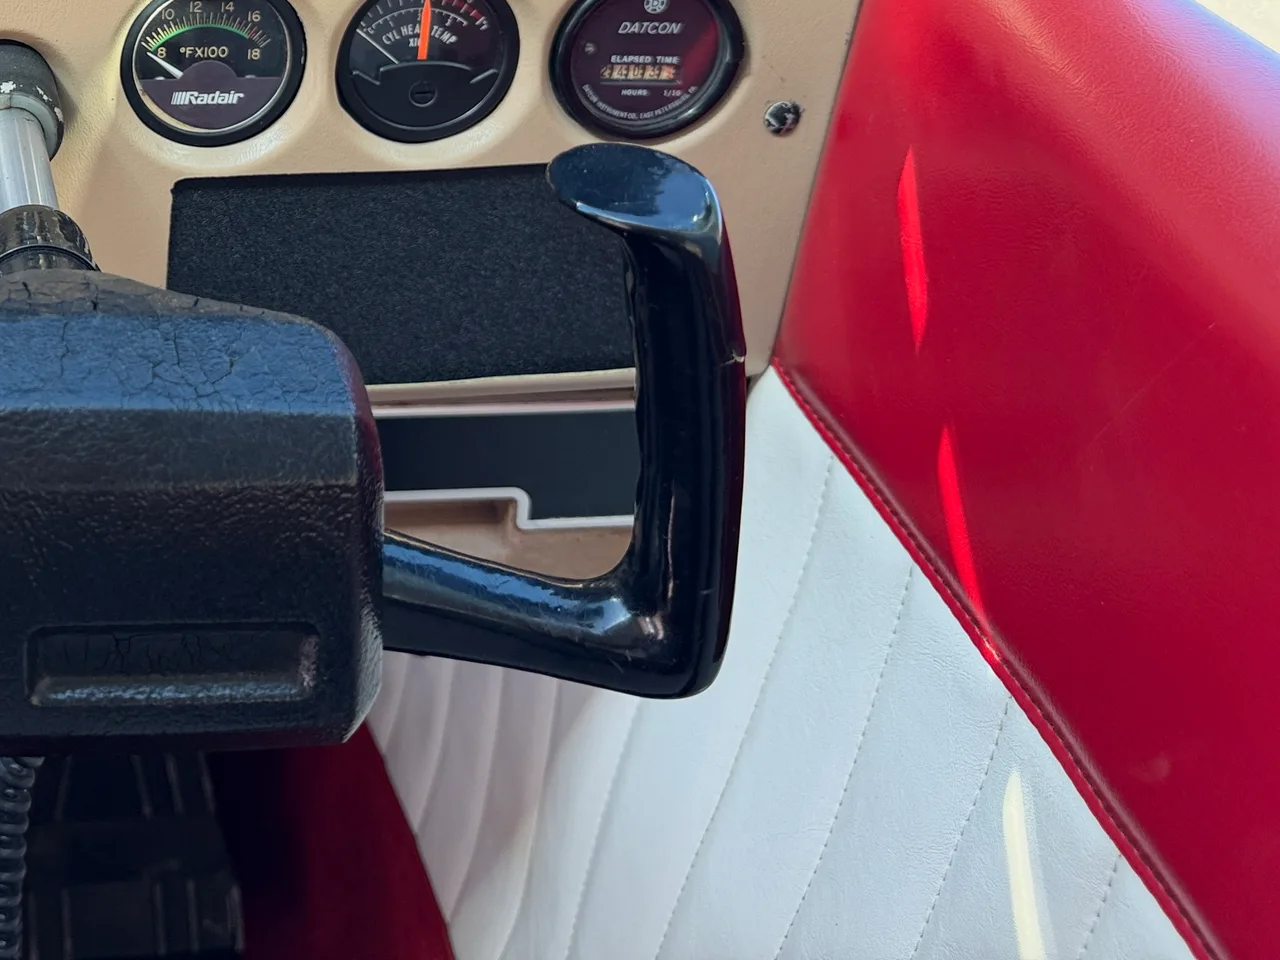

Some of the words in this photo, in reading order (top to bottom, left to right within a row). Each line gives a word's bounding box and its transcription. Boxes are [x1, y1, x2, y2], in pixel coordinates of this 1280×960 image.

[190, 2, 202, 12] 12
[221, 2, 234, 12] 14
[161, 9, 175, 20] 10
[248, 11, 260, 21] 16
[618, 21, 682, 34] DATCON
[431, 25, 458, 45] TEMP
[247, 49, 260, 60] 18
[611, 55, 651, 64] ELAPSED
[656, 56, 680, 64] TIME
[183, 91, 245, 105] Radair
